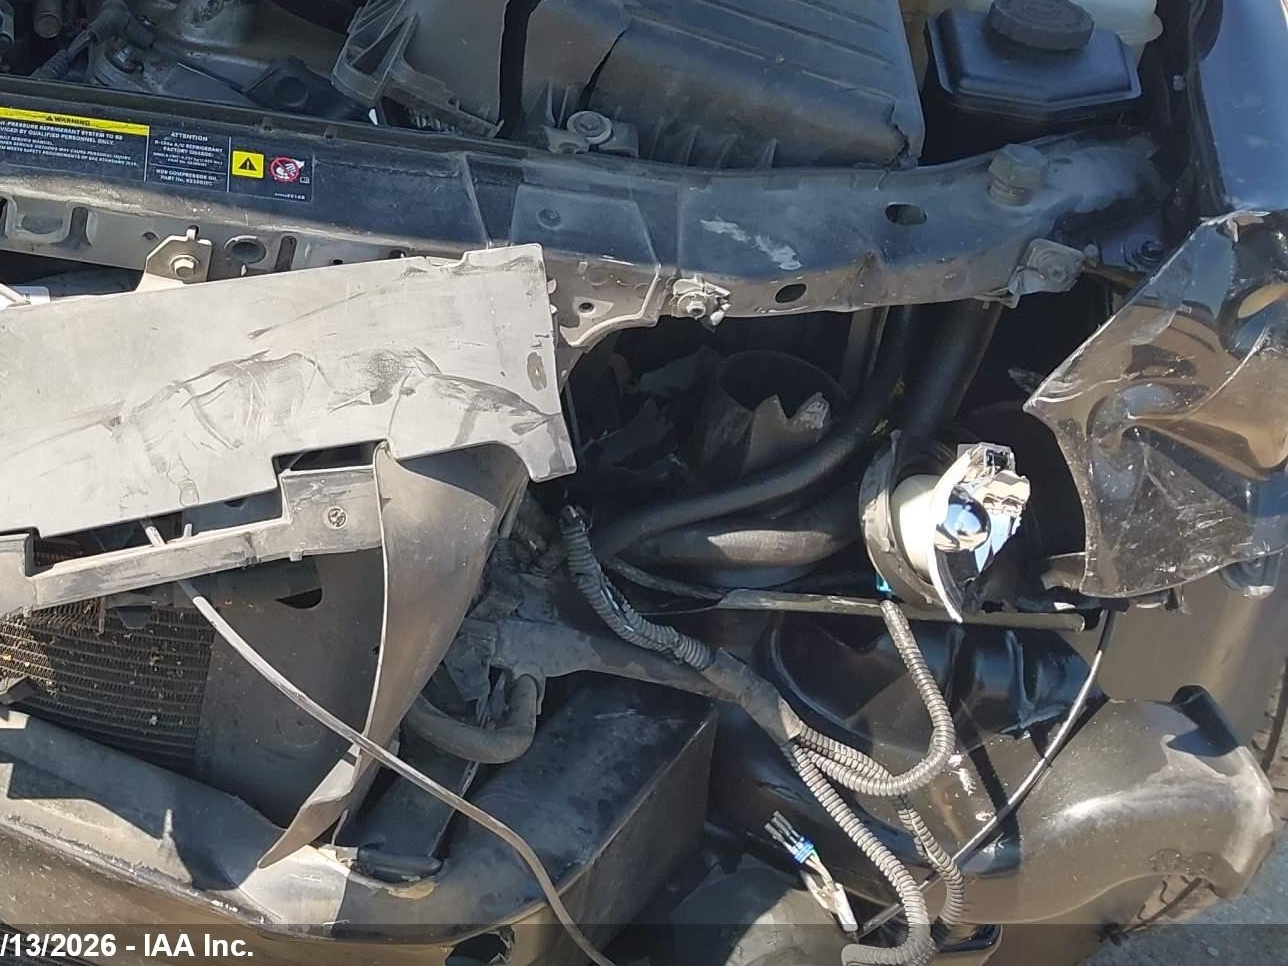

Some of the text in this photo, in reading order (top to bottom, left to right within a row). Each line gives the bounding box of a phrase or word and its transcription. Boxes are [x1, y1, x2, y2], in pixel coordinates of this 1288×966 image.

[54, 116, 91, 126] WARNING
[28, 129, 59, 138] QUALIFIED
[60, 134, 96, 143] PERSONNEL
[170, 131, 208, 141] ATTENTION
[185, 143, 222, 152] REFRIGERANT
[168, 170, 206, 179] COMPRESSOR
